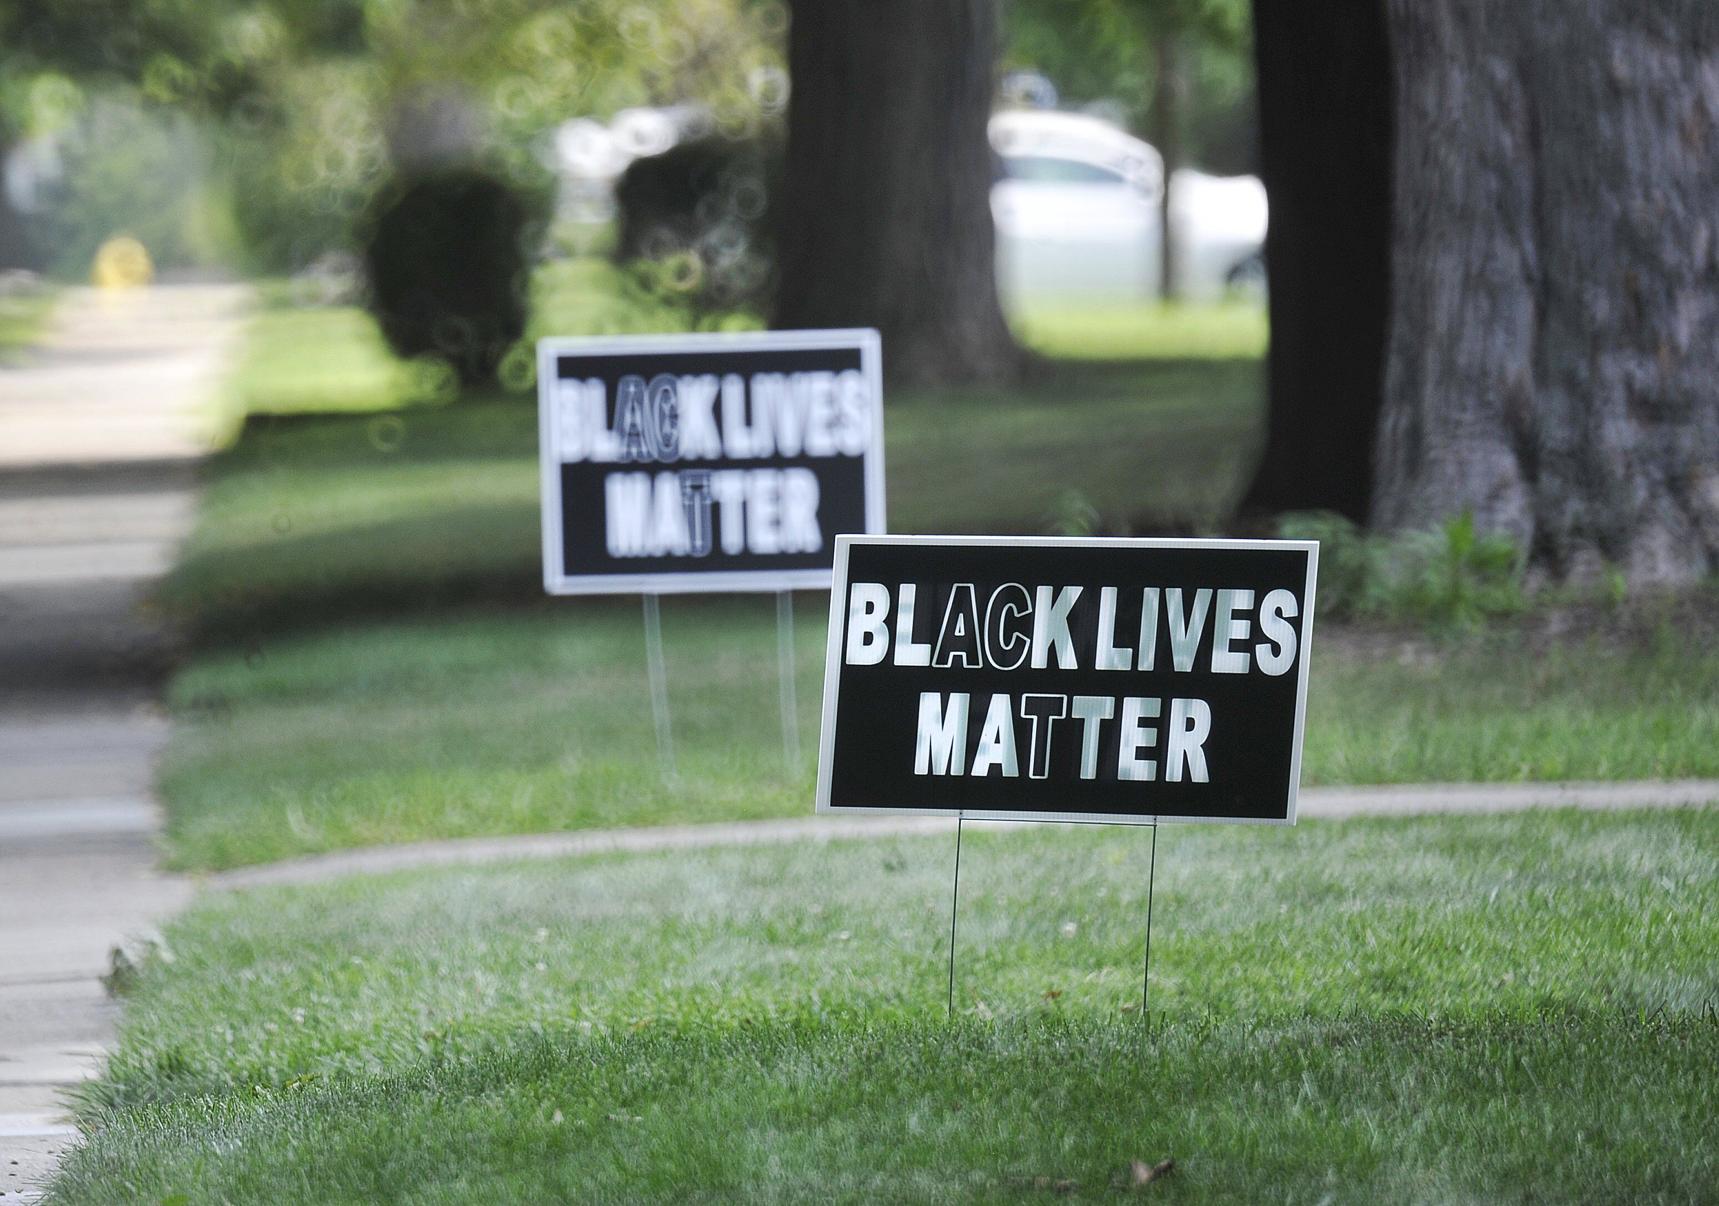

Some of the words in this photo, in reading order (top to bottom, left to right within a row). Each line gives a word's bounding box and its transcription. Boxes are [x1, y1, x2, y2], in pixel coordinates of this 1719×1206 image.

[557, 373, 722, 463] BLACK
[722, 369, 867, 458] LIVES
[605, 467, 822, 558] MATTER
[845, 582, 1084, 671] BLACK
[1095, 586, 1300, 677] LIVES
[914, 691, 1212, 784] MATTER
